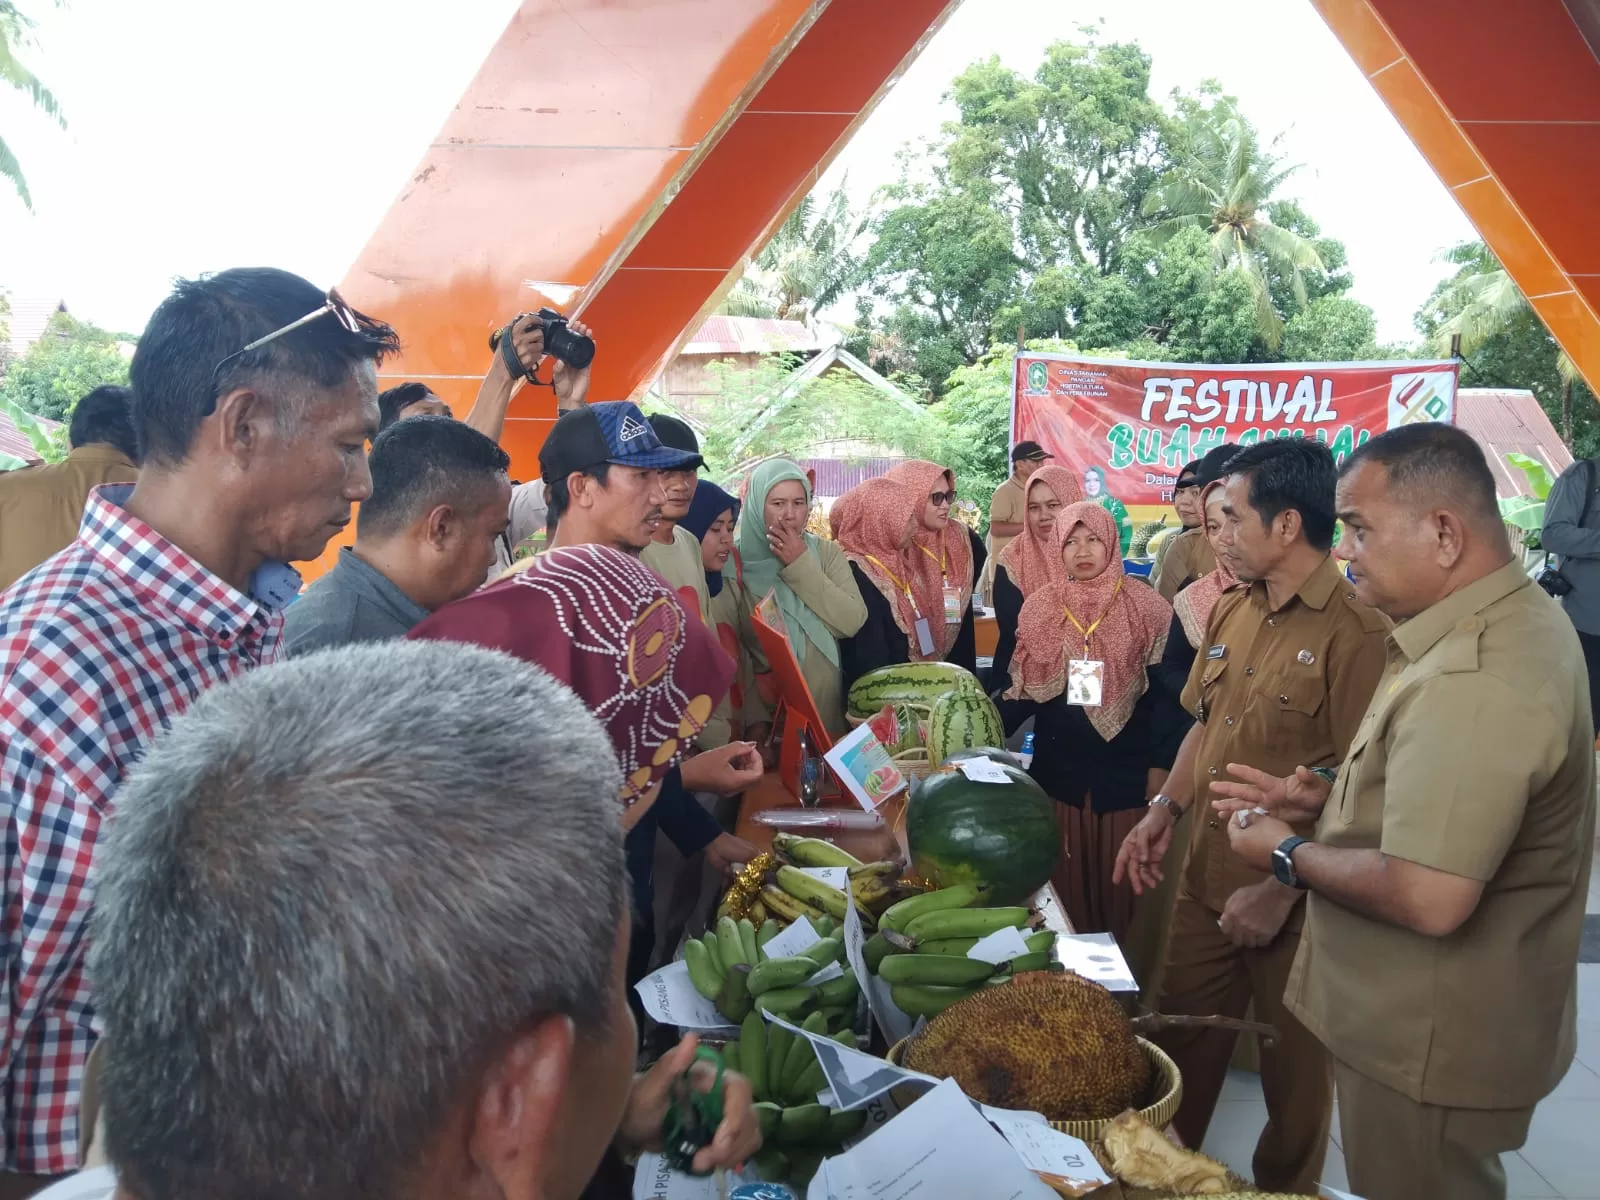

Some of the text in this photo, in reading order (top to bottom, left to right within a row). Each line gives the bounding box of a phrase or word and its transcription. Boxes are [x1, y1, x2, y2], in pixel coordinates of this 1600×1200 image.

[1141, 375, 1338, 424] FESTIVAL
[1107, 422, 1227, 470] BUAH
[1062, 1154, 1085, 1168] 02
